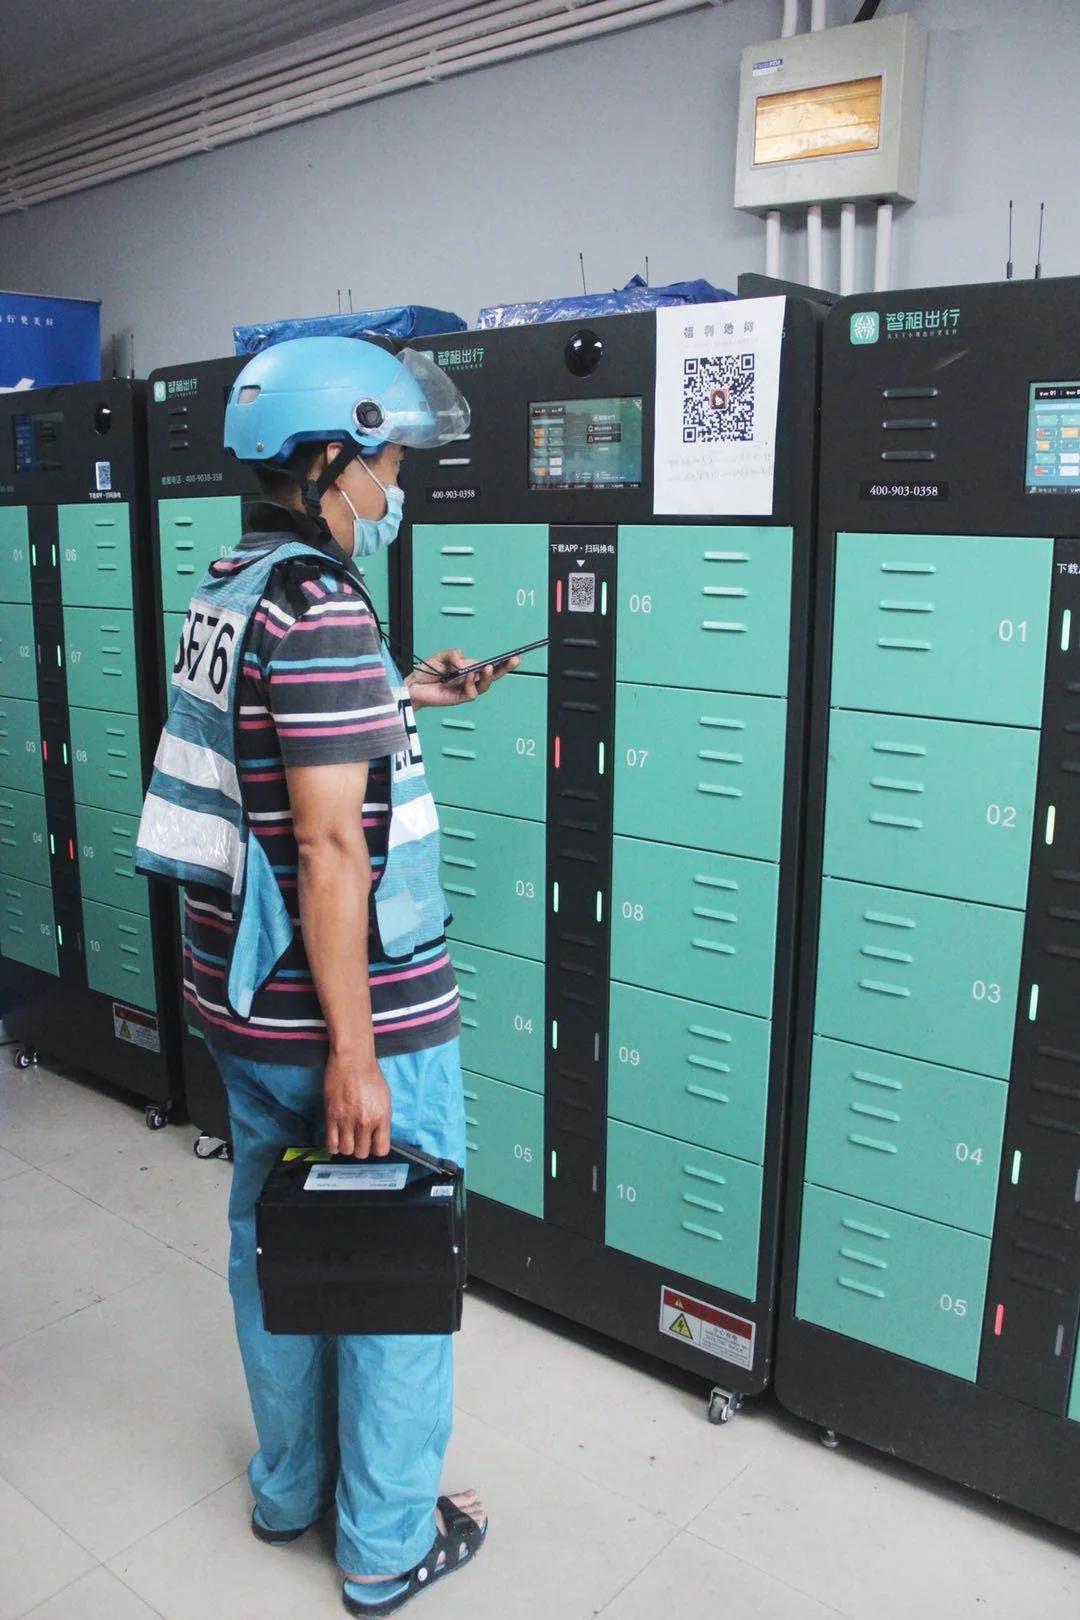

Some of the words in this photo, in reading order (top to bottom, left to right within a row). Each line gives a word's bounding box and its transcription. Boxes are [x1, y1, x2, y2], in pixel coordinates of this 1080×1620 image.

[886, 308, 960, 331] 智租出行
[432, 489, 475, 499] 400-903-0358
[869, 485, 938, 496] 400-903-0358
[12, 549, 23, 561] 01
[65, 549, 77, 561] 06
[1057, 563, 1080, 574] 下载
[516, 588, 535, 607] 01
[629, 594, 652, 614] 06
[998, 619, 1028, 642] 01
[19, 646, 30, 658] 02
[71, 651, 82, 664] 07
[25, 740, 36, 753] 03
[76, 750, 87, 762] 08
[515, 737, 536, 757] 02
[626, 748, 649, 768] 07
[986, 803, 1017, 828] 02
[32, 832, 43, 845] 04
[83, 845, 94, 858] 09
[515, 879, 535, 899] 03
[622, 901, 644, 922] 08
[89, 939, 101, 952] 10
[972, 980, 1001, 1004] 03
[514, 1015, 534, 1034] 04
[619, 1046, 640, 1066] 09
[514, 1143, 533, 1163] 05
[955, 1142, 984, 1166] 04
[617, 1183, 637, 1203] 10
[939, 1294, 967, 1317] 05
